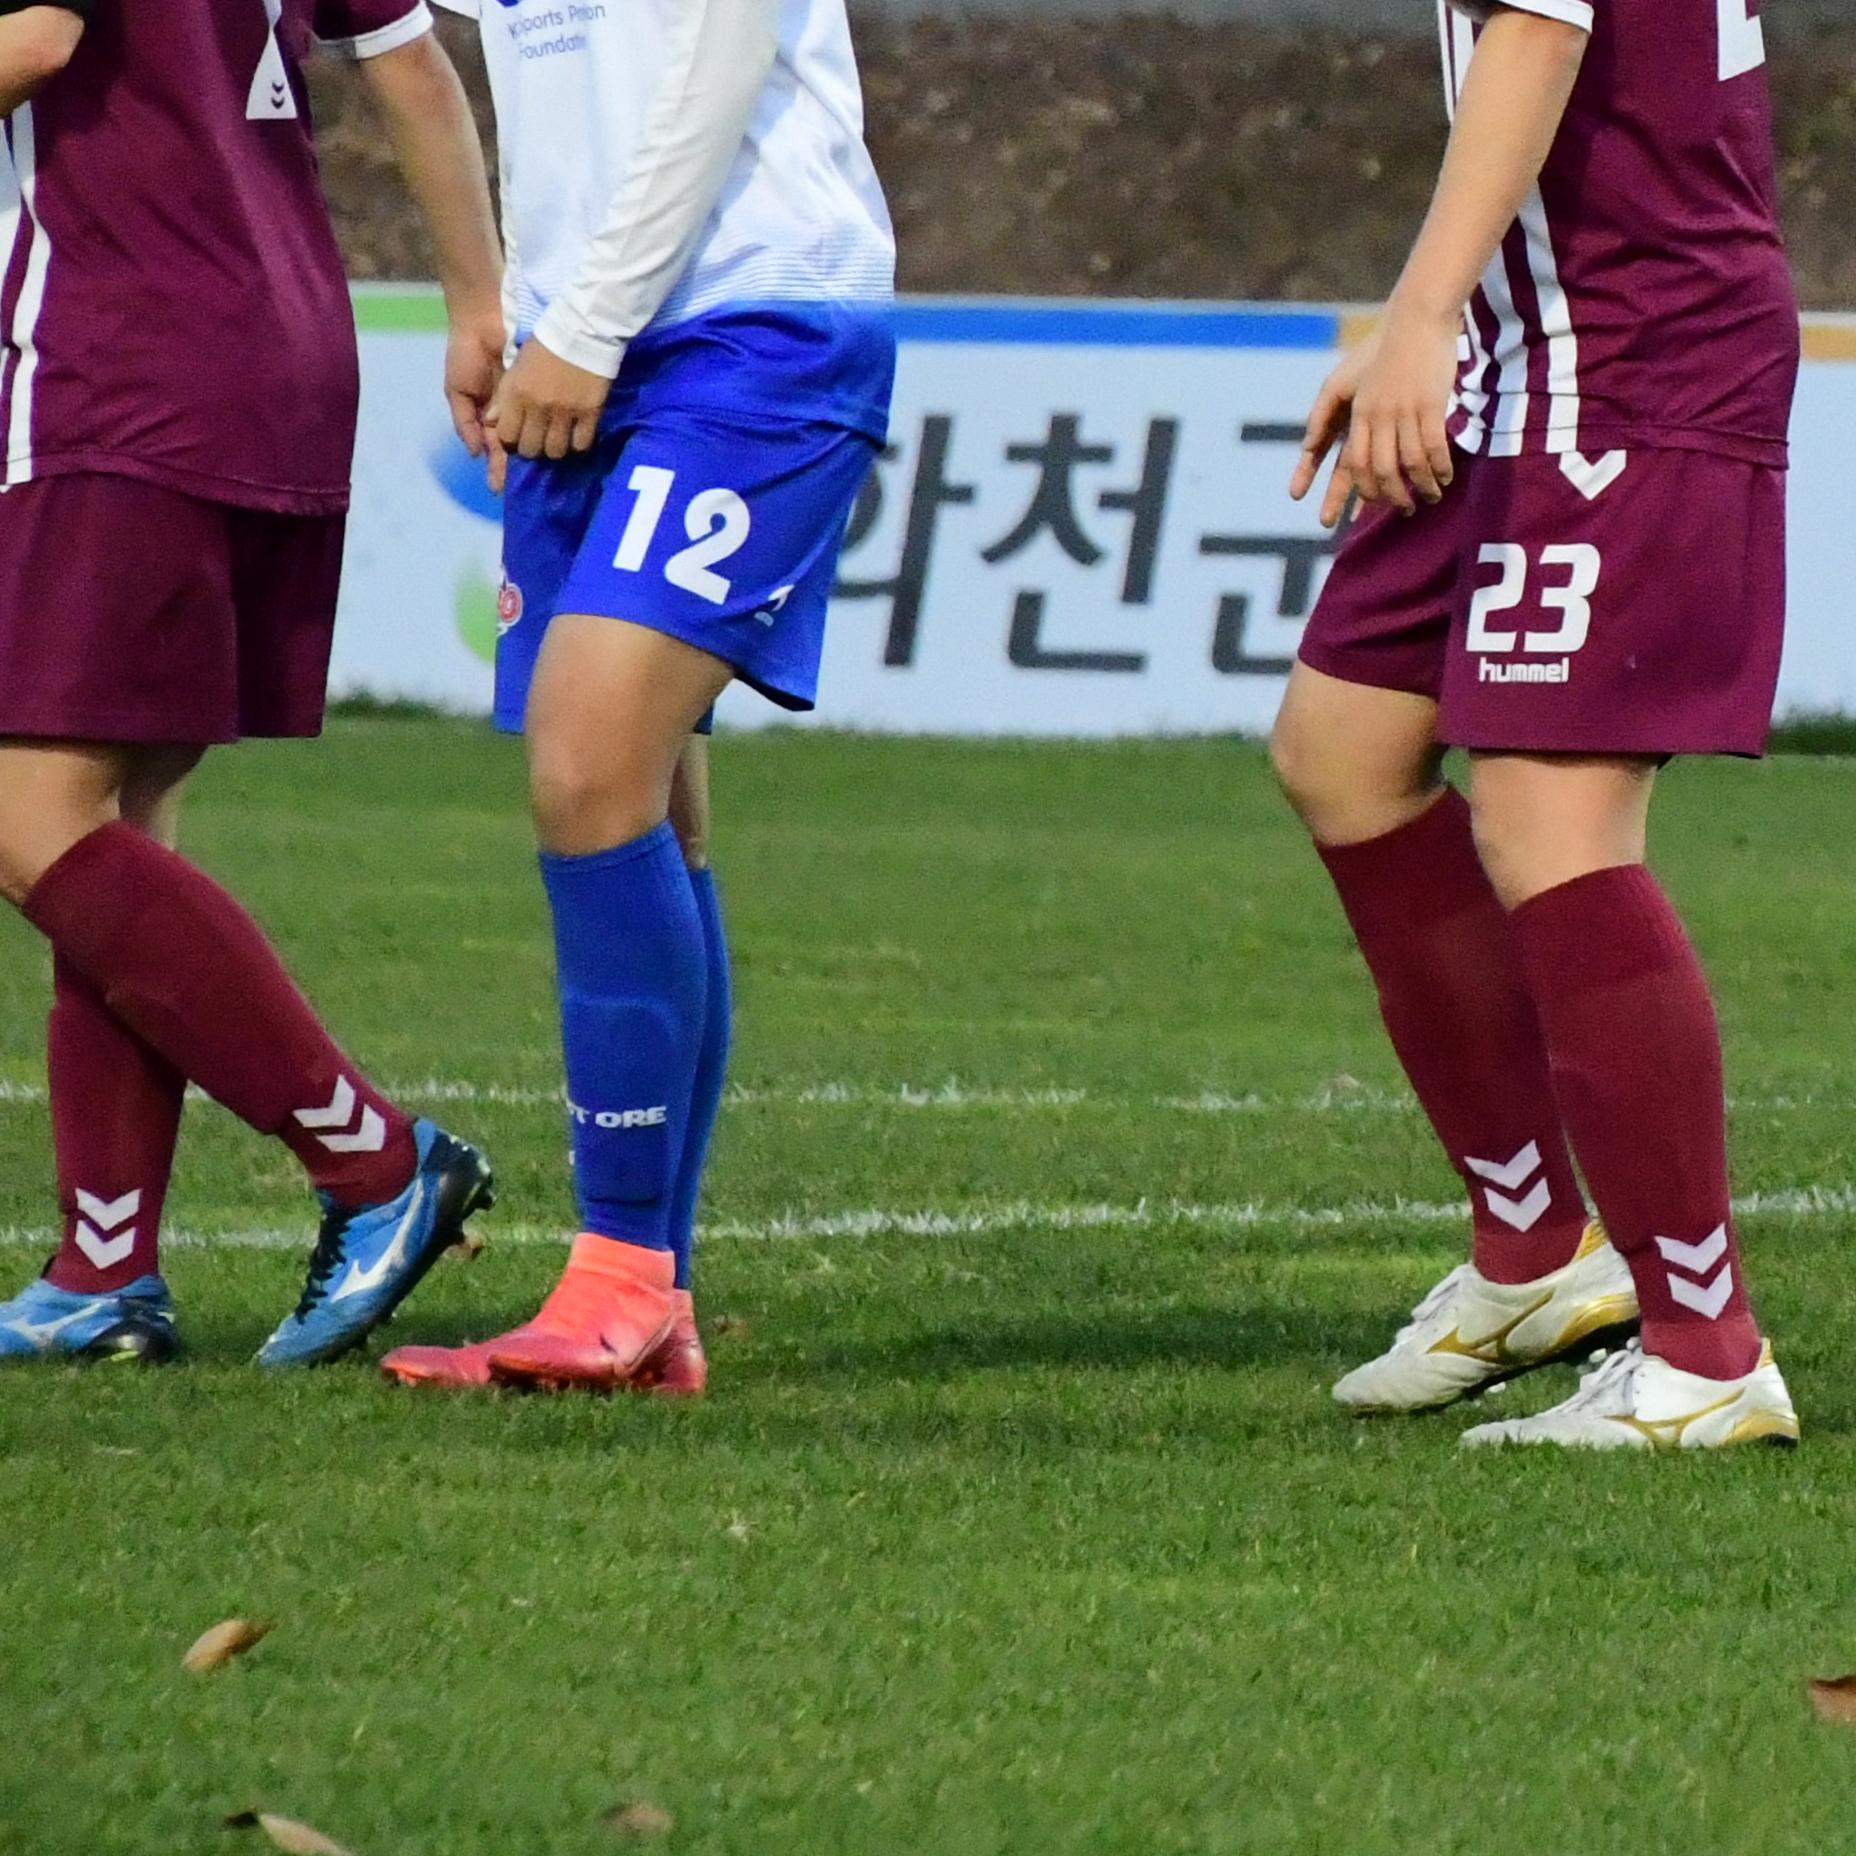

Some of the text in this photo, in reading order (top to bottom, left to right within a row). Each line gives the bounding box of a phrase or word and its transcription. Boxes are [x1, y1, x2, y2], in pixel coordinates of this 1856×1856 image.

[613, 466, 752, 605] 12
[1466, 544, 1600, 652] 23
[1478, 657, 1569, 684] hummel
